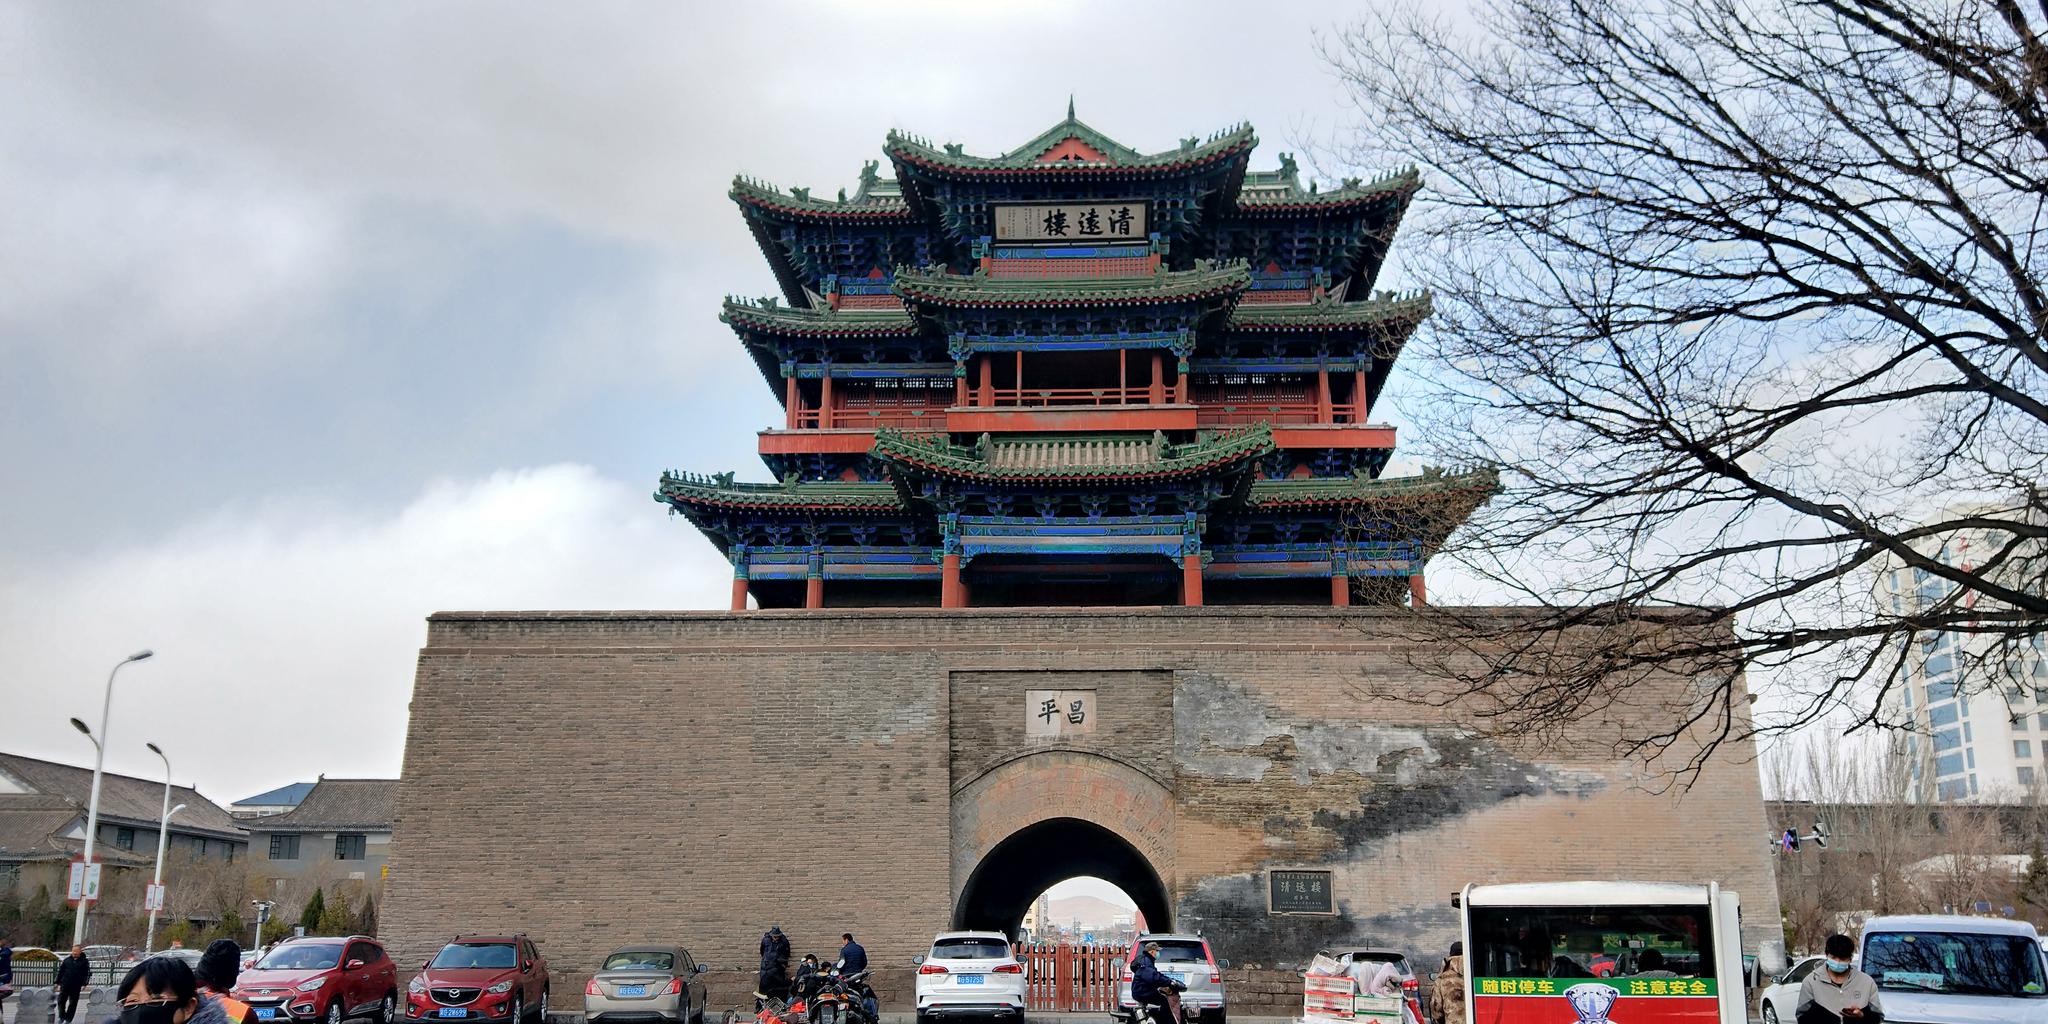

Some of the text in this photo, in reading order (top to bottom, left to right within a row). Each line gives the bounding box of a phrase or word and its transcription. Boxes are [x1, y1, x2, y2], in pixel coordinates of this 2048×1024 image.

[1037, 698, 1086, 725] 昌平
[1482, 980, 1707, 995] 随时停车 注意安全
